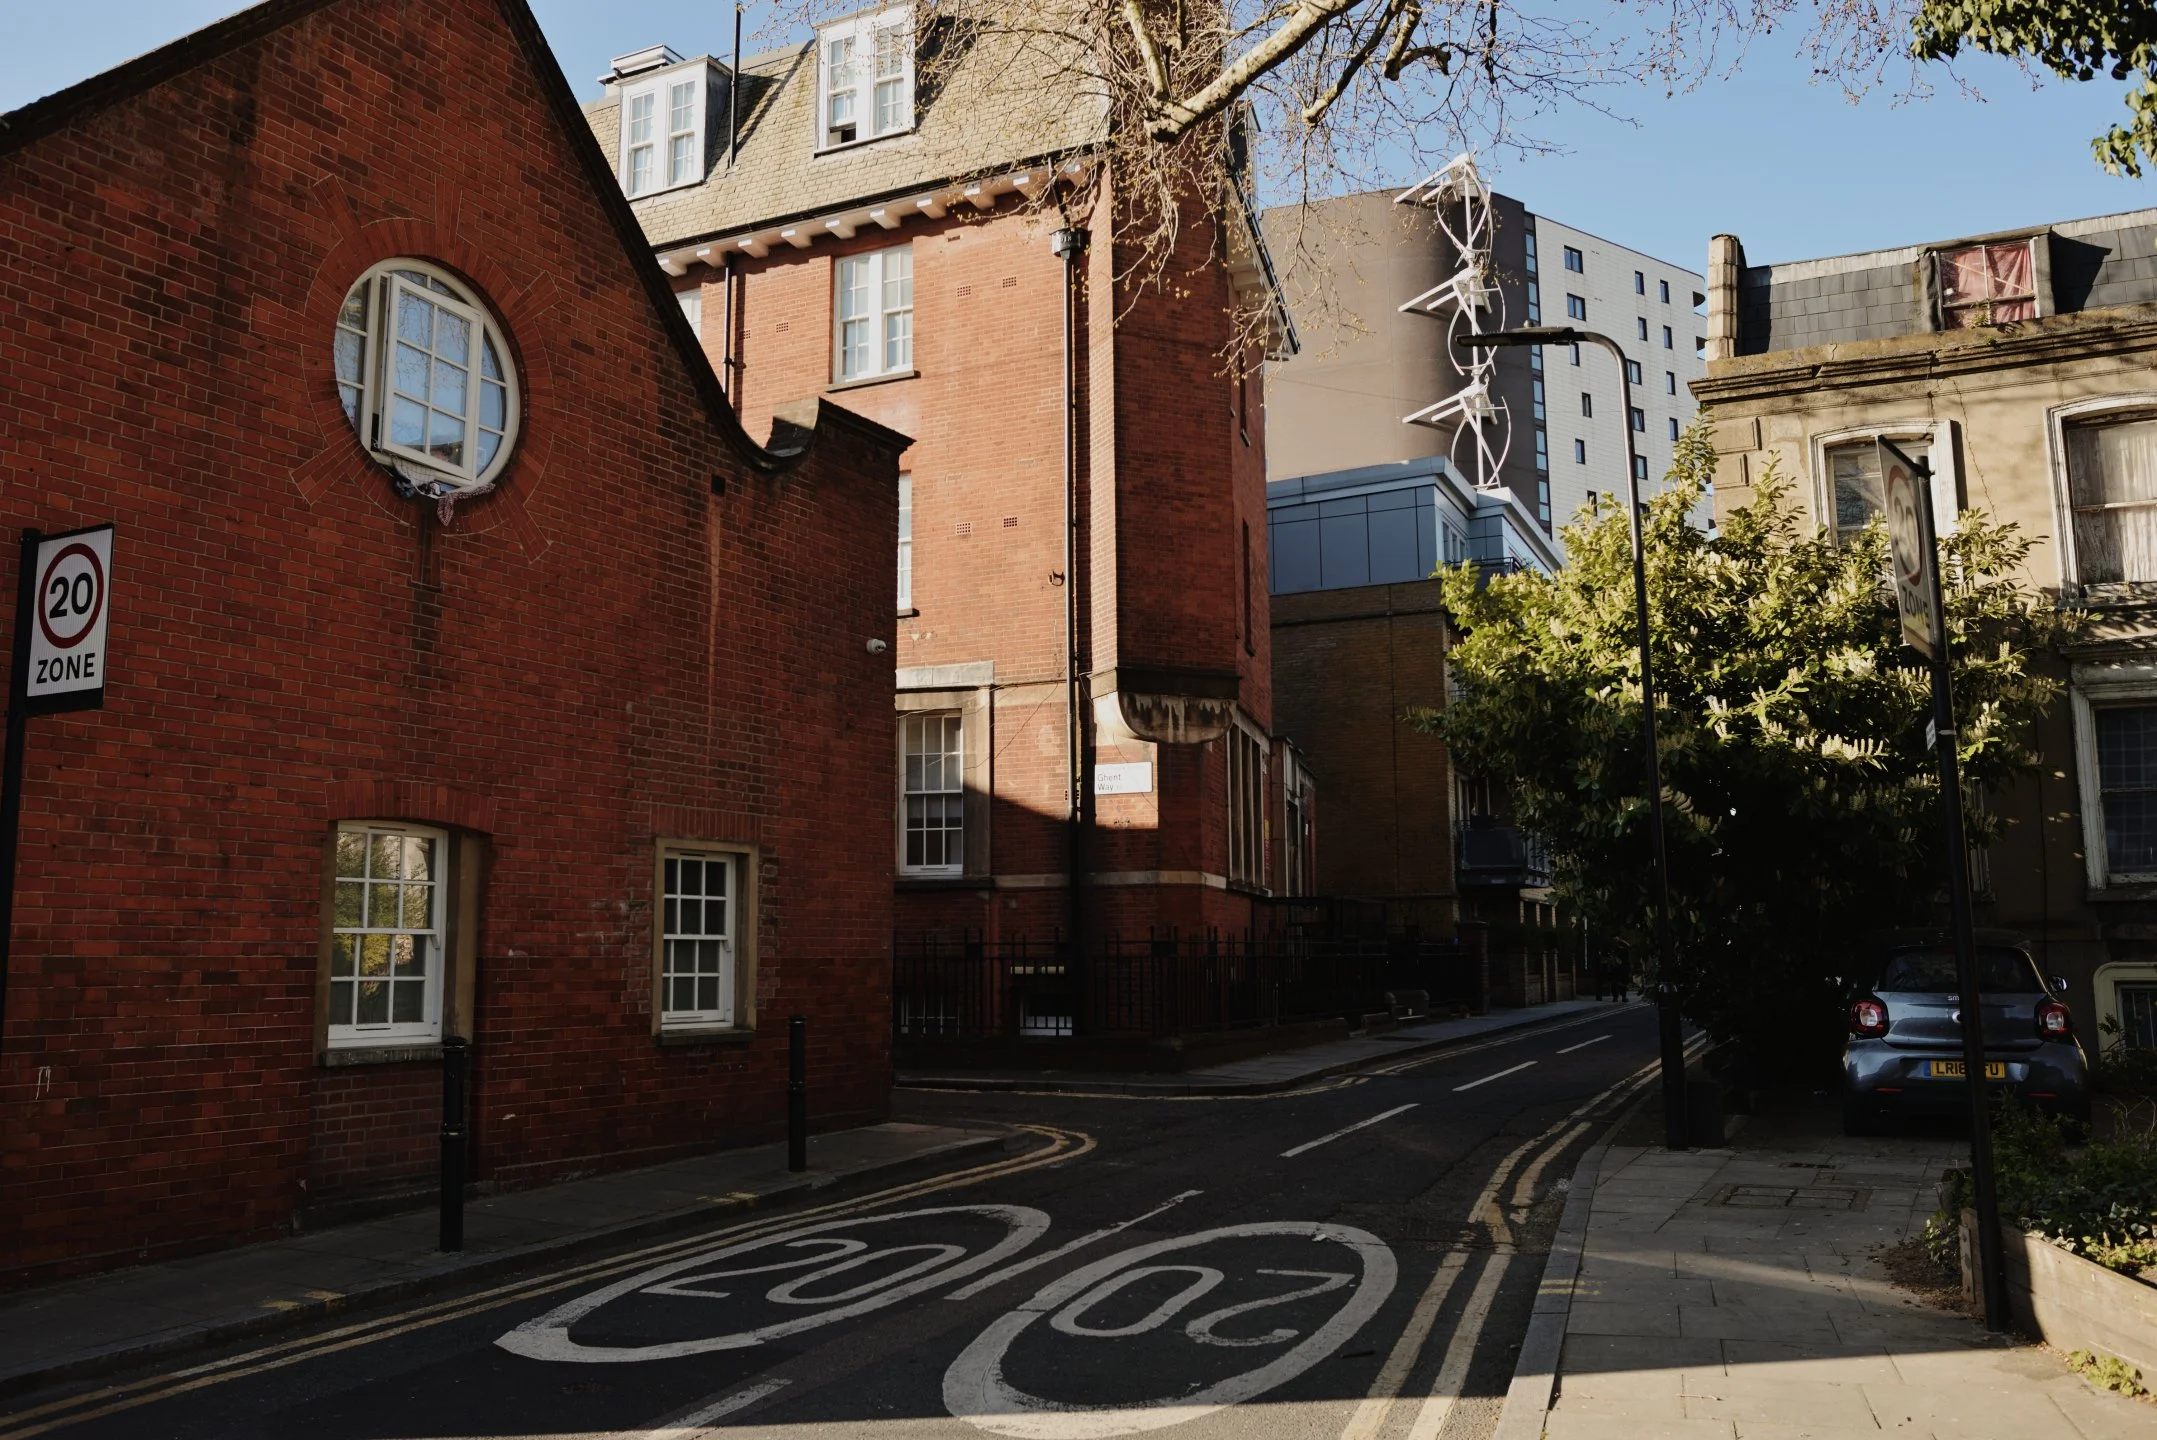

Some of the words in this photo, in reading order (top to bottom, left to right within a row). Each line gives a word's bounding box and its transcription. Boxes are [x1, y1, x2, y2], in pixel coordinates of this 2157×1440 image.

[1893, 496, 1917, 552] 20
[49, 572, 94, 619] 20
[1902, 585, 1931, 629] ZONE
[36, 652, 96, 684] ZONE
[1097, 773, 1121, 782] Ghent
[1097, 783, 1114, 792] Way
[639, 1238, 967, 1305] 20
[1050, 1265, 1355, 1347] 20
